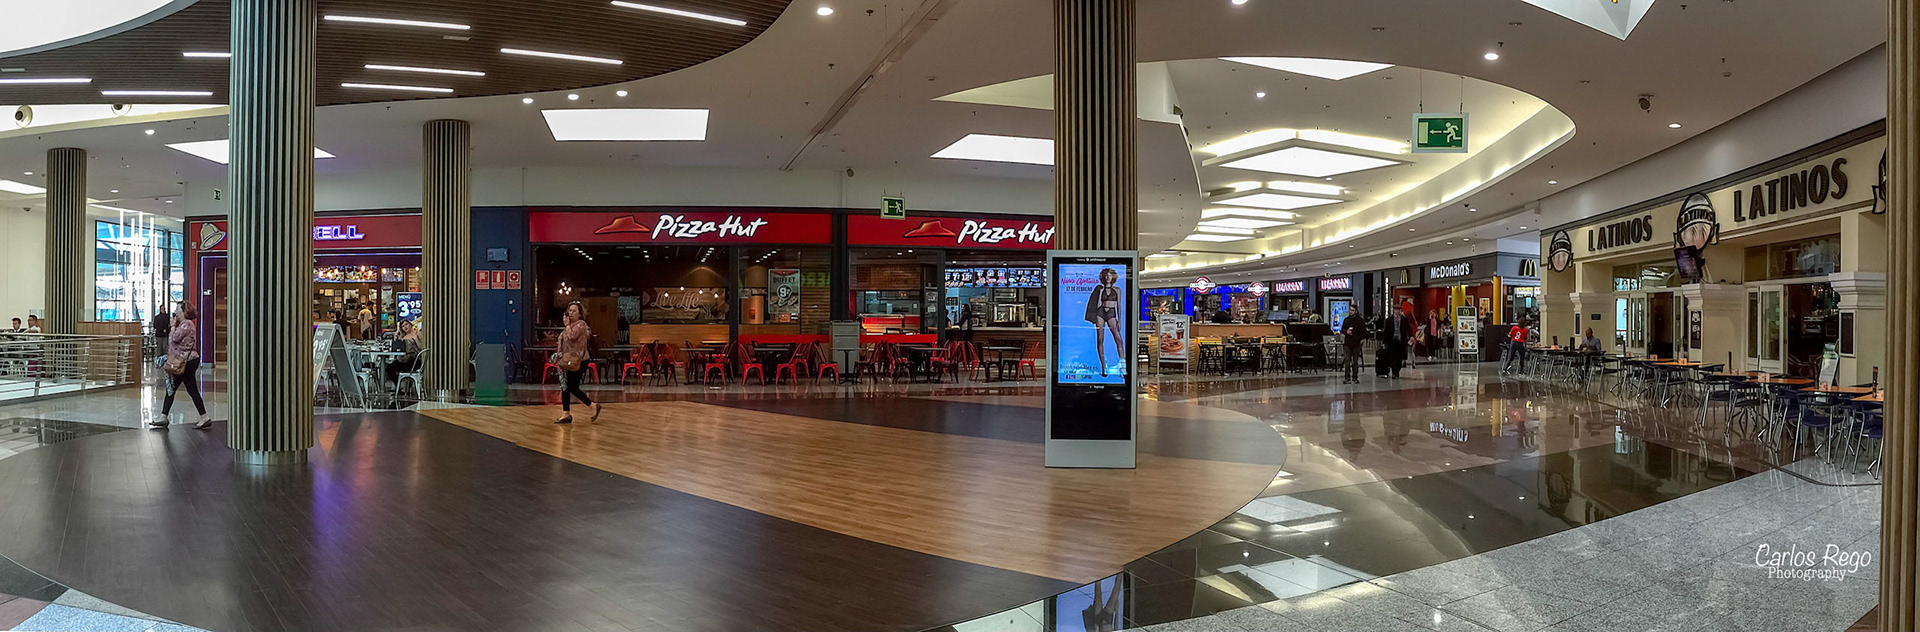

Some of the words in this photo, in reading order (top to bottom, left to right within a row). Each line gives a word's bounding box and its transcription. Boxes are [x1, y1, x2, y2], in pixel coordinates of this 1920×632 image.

[1734, 157, 1848, 222] LATINOS
[652, 214, 716, 240] Pizza
[718, 215, 768, 238] Hut
[957, 220, 1016, 244] Pizza
[1017, 222, 1055, 244] Hut
[1588, 214, 1652, 252] LATINOS
[1430, 262, 1471, 279] McDonald's
